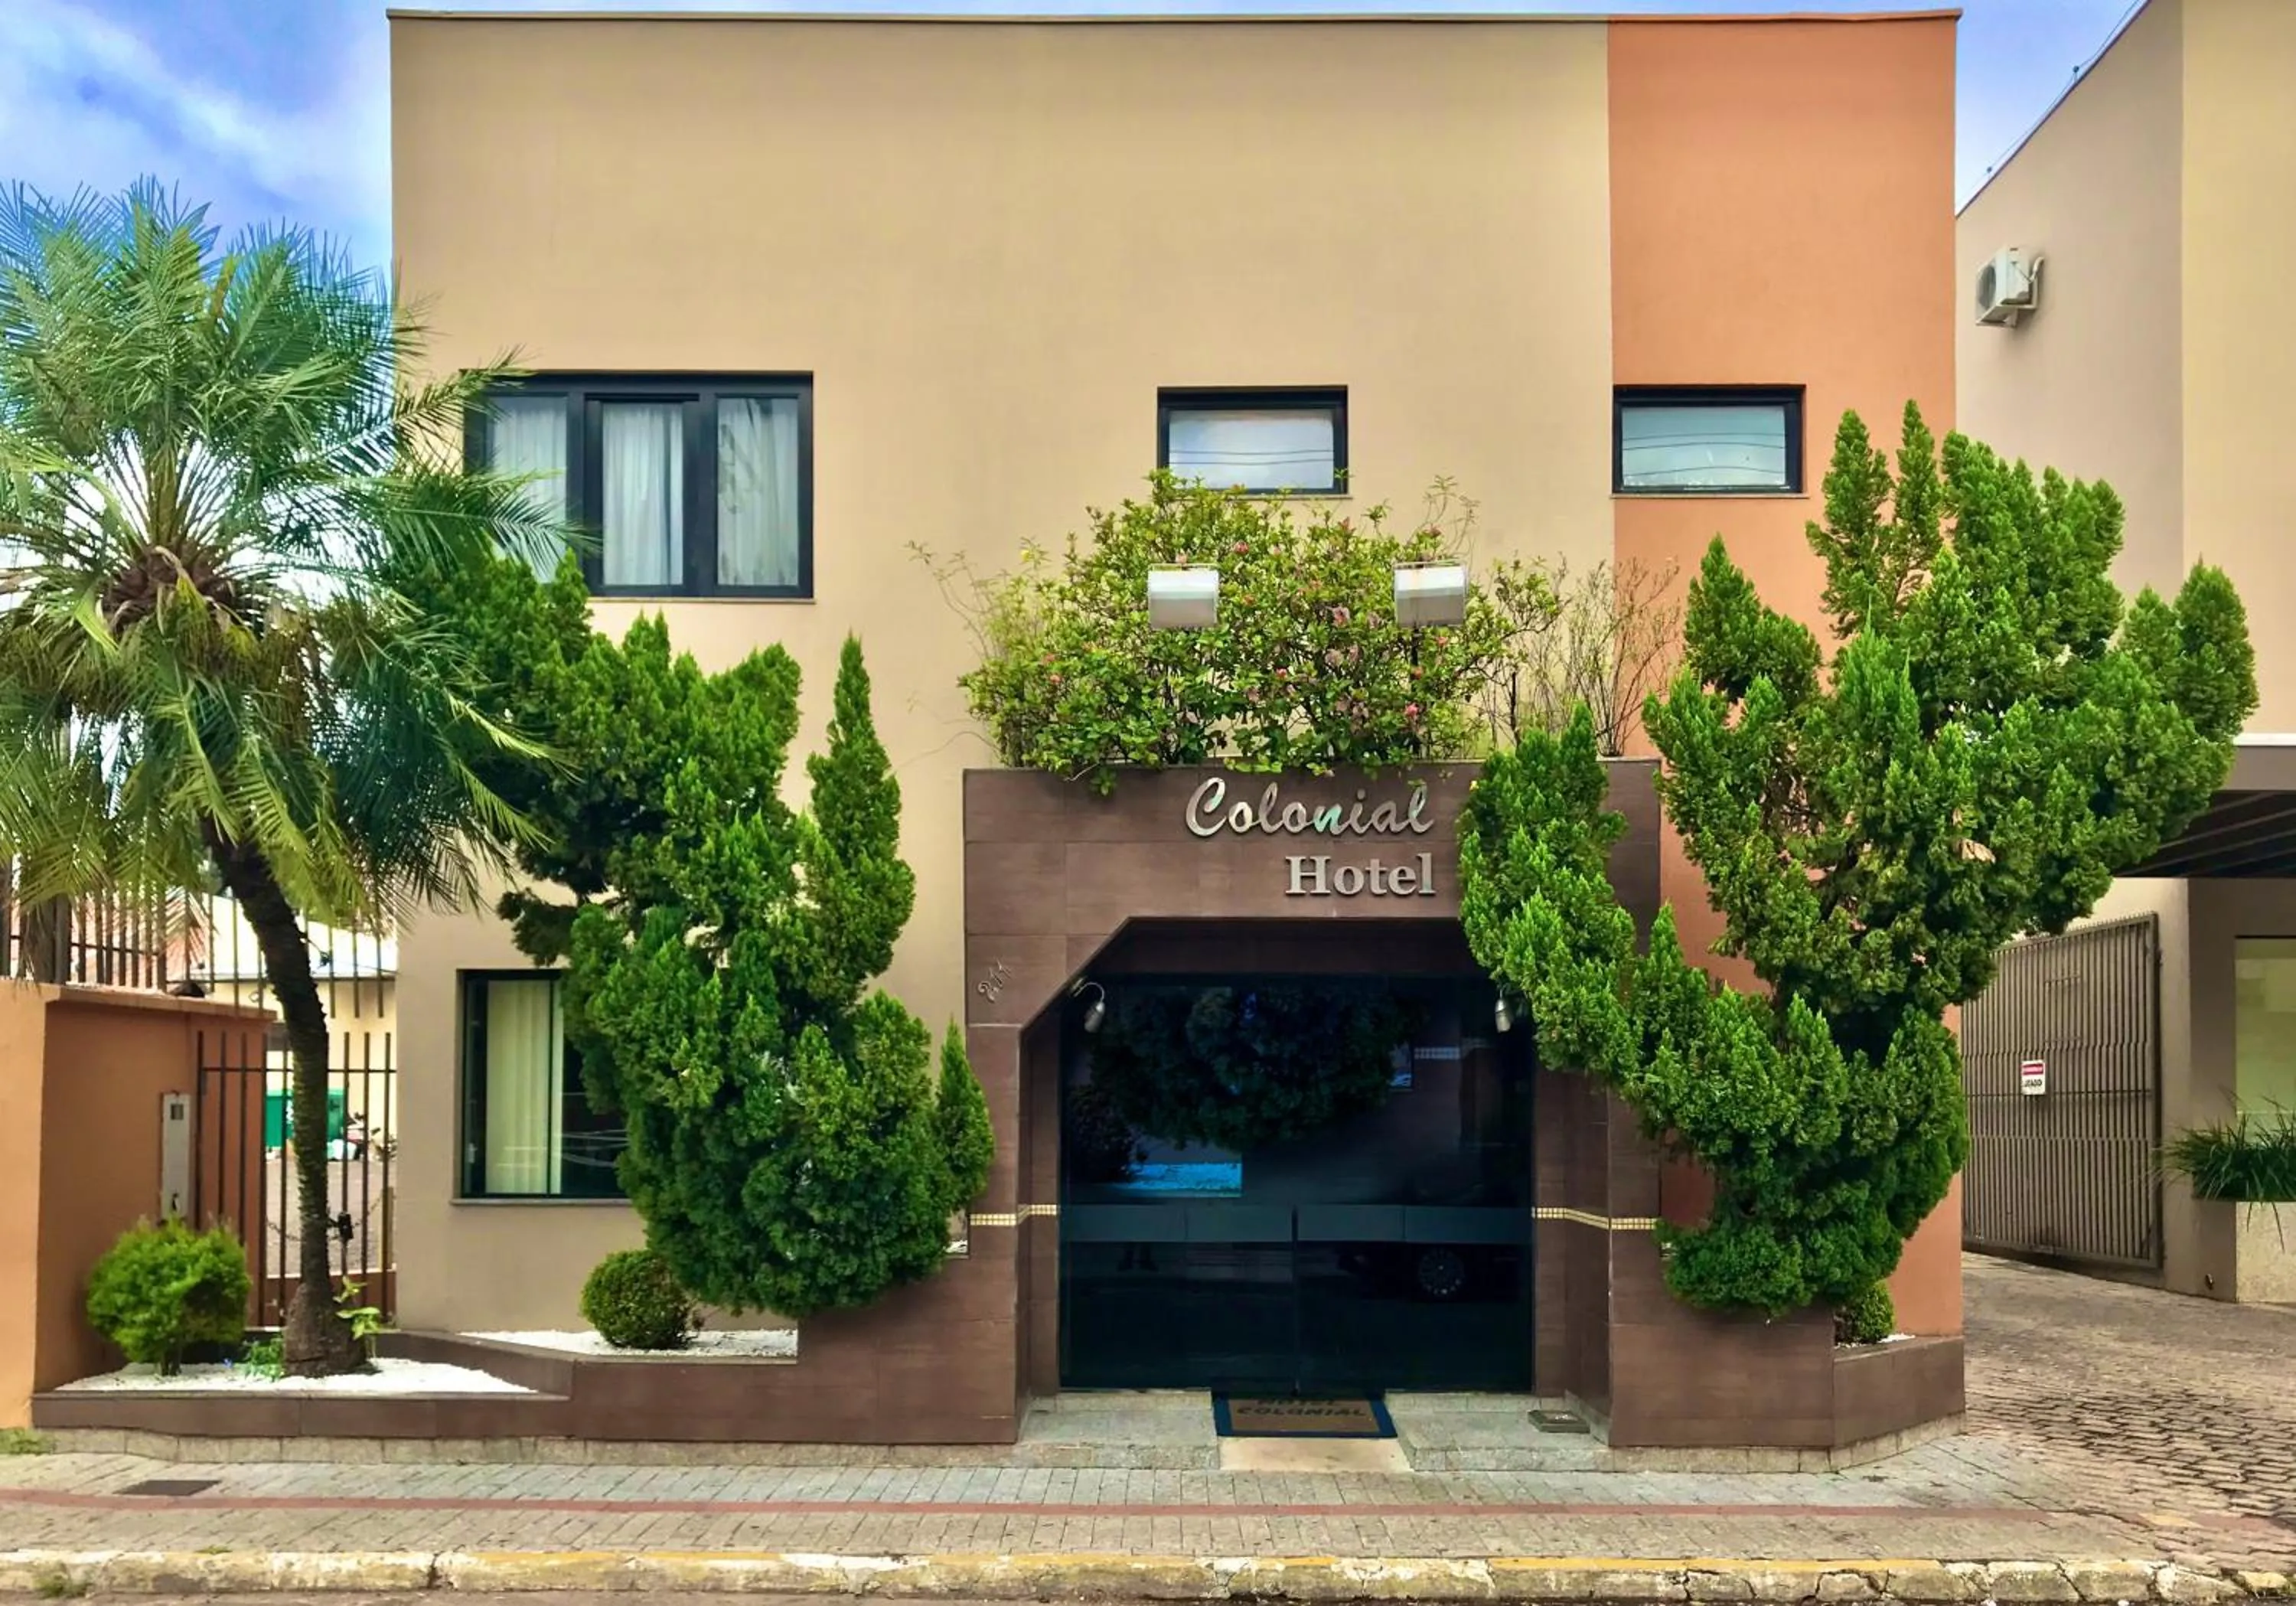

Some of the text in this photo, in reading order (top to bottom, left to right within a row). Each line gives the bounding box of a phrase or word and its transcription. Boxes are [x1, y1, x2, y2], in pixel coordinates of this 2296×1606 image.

[1185, 776, 1435, 837] Colonial
[1284, 852, 1437, 896] Hotel
[1236, 1406, 1367, 1416] COLONIAL
